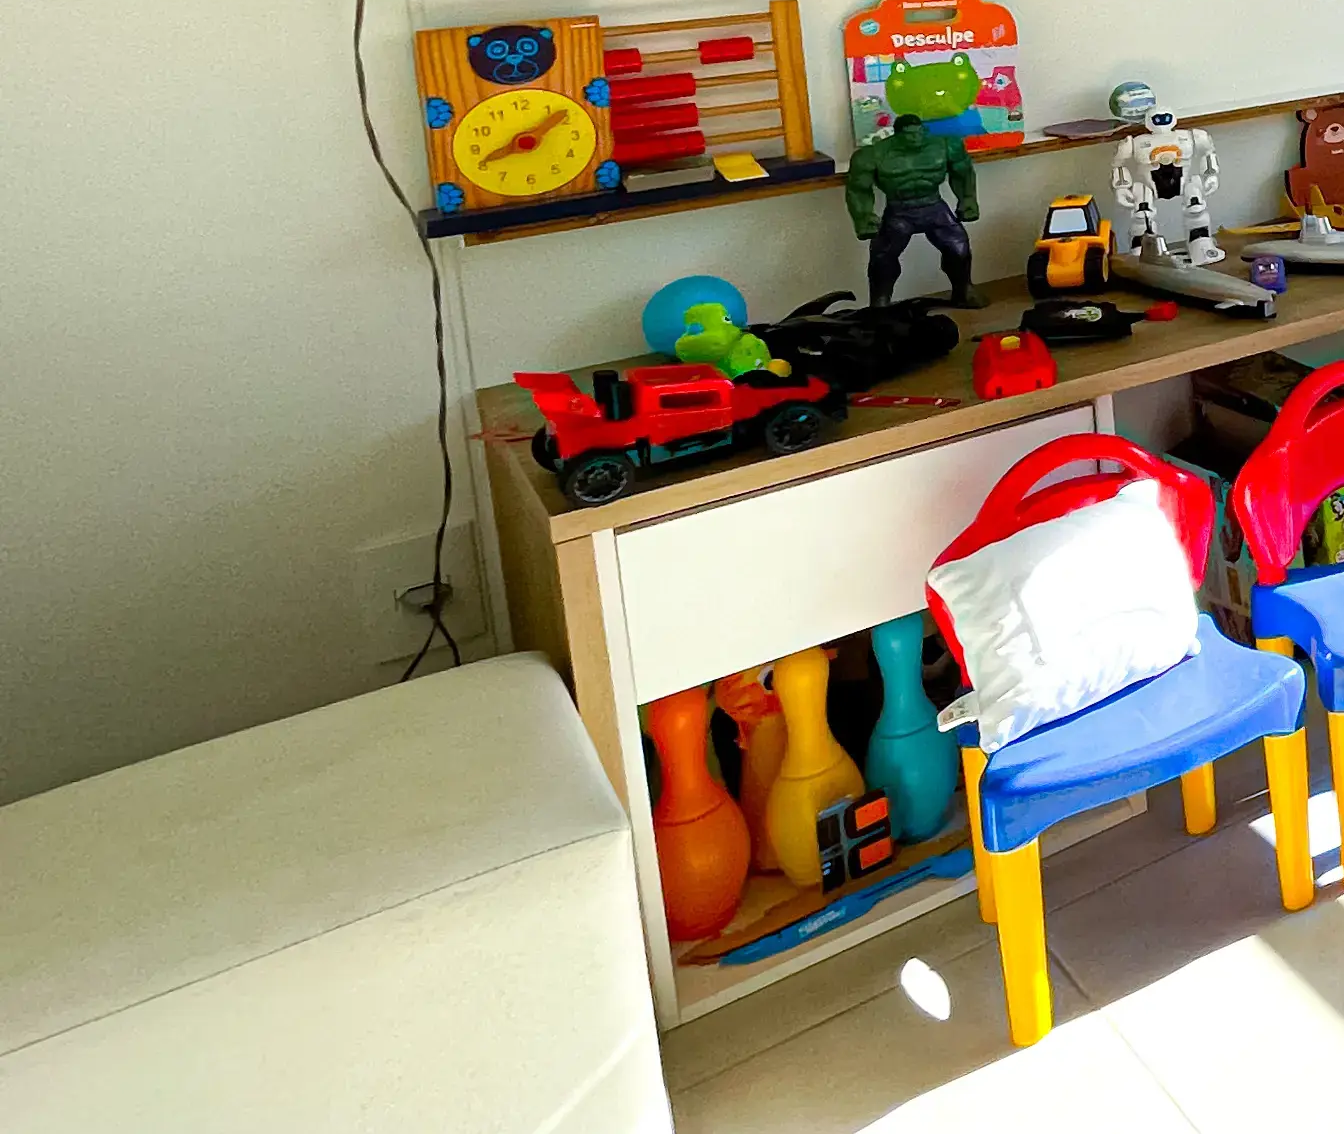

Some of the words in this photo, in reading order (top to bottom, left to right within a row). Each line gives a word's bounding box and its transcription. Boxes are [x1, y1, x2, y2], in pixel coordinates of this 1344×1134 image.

[889, 26, 976, 49] Desculpe
[511, 99, 531, 111] 12
[489, 110, 504, 121] 11
[472, 126, 492, 137] 10
[571, 130, 581, 141] 3
[565, 148, 575, 158] 4
[550, 164, 562, 175] 5
[499, 171, 507, 182] 7
[526, 174, 537, 185] 6
